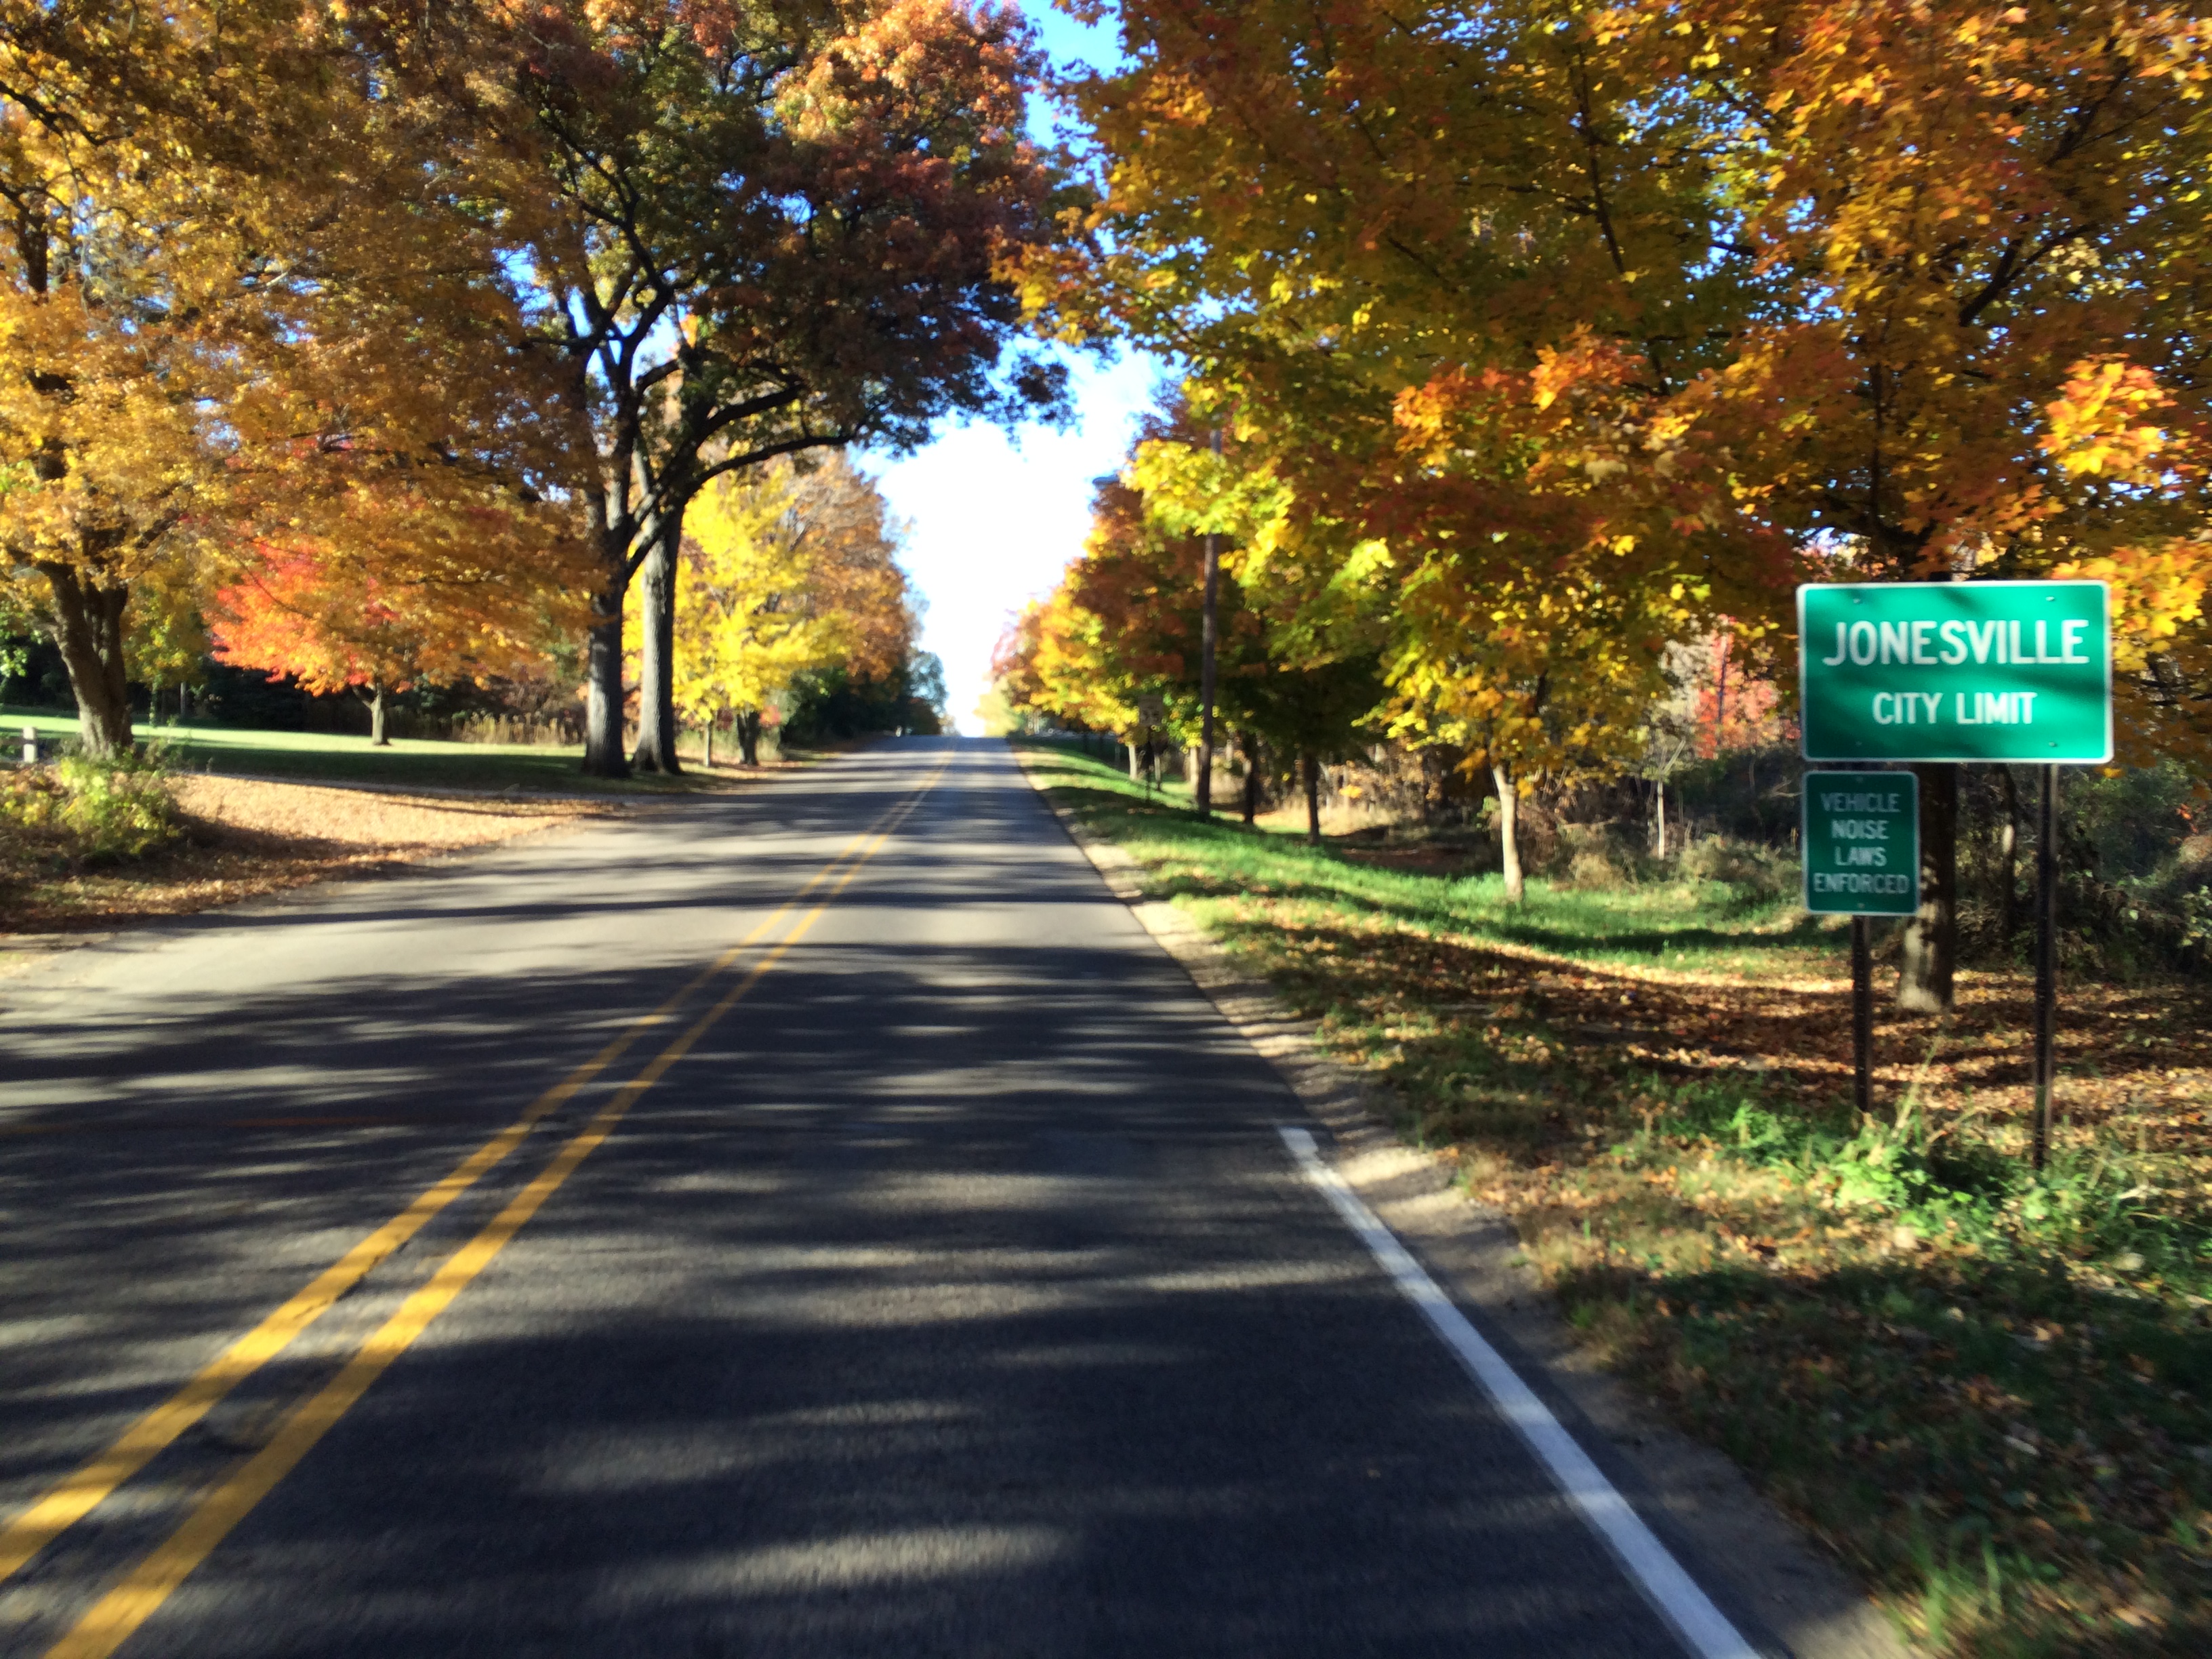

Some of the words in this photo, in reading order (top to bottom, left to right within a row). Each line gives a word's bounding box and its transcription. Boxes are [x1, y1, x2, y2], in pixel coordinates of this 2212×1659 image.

[1822, 619, 2090, 666] JONESVILLE
[1872, 692, 1943, 724] CITY
[1956, 692, 2037, 724] LIMIT
[1820, 792, 1901, 813] VEHICLE
[1831, 819, 1889, 839] NOISE
[1835, 846, 1887, 867] LAWS
[1813, 872, 1910, 894] ENFORCED
